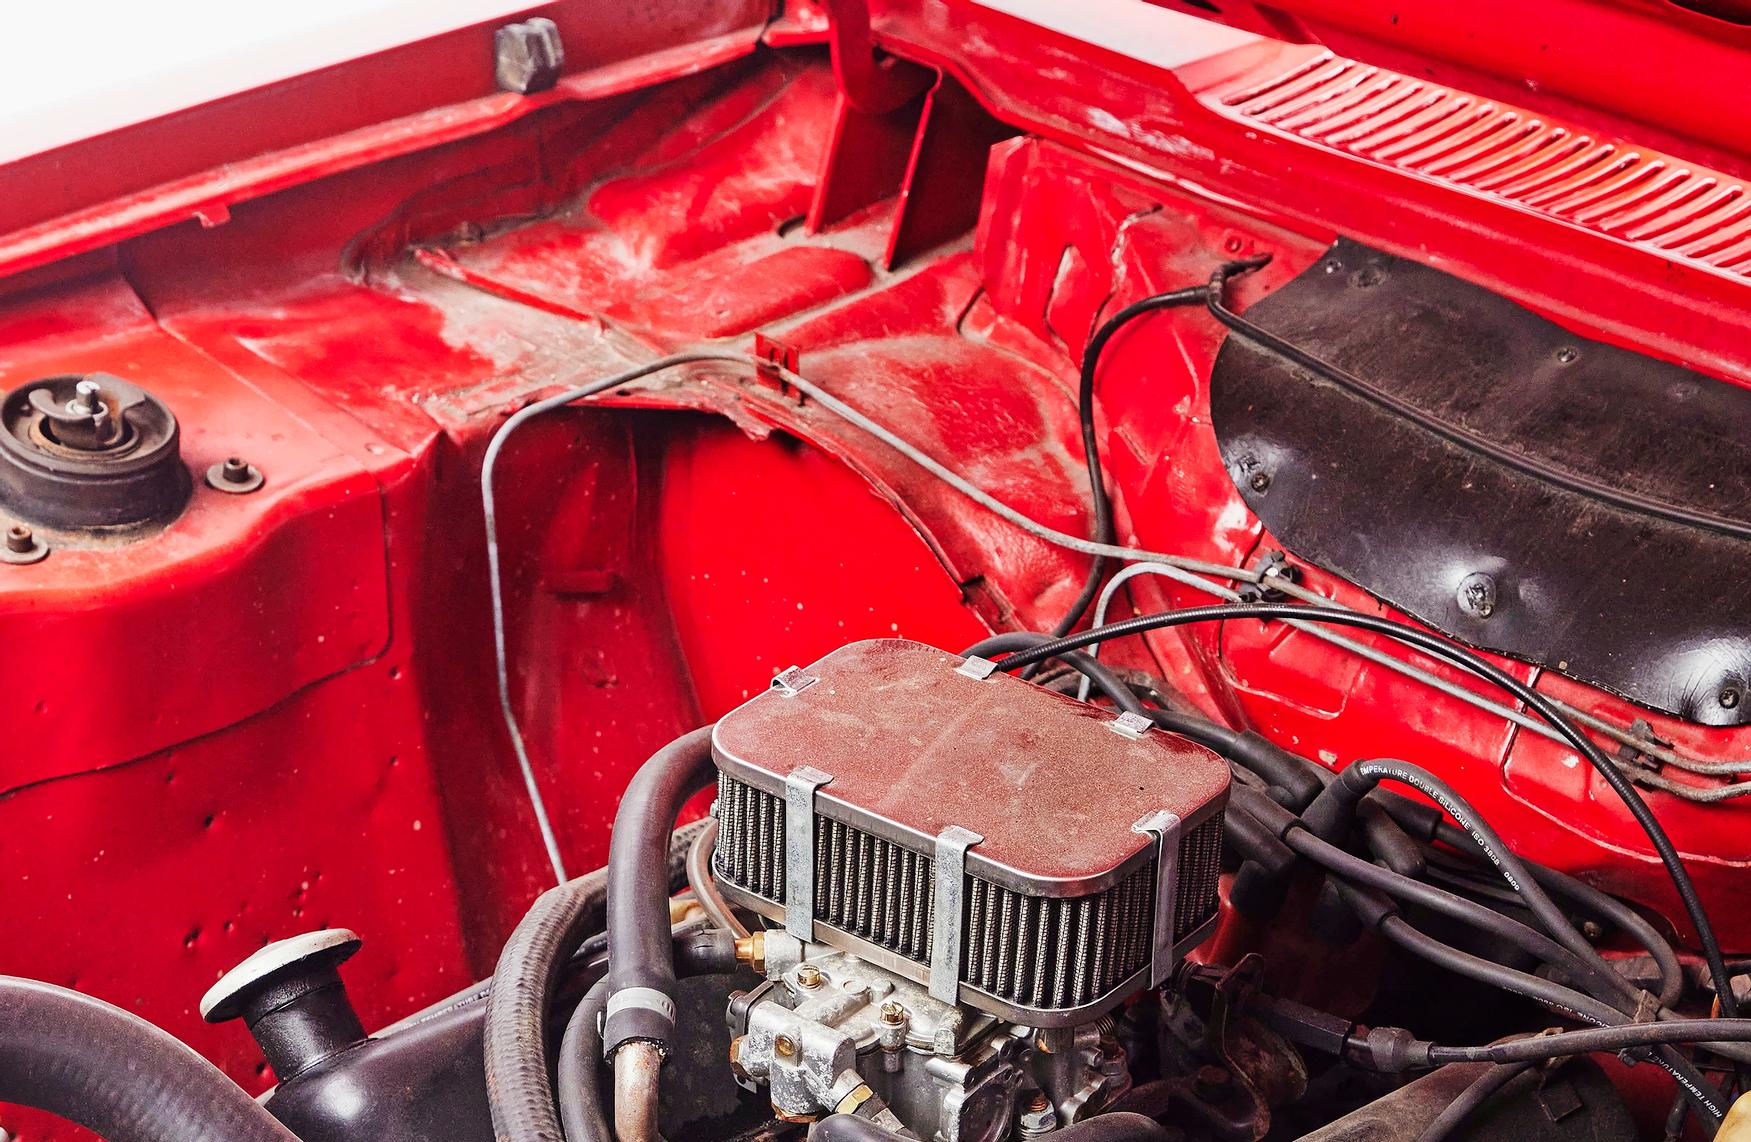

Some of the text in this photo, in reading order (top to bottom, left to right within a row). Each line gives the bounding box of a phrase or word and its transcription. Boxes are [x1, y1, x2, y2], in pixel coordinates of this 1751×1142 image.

[1409, 774, 1439, 799] DOUBLE
[1438, 797, 1472, 831] SILICONE
[1471, 830, 1485, 846] ISO
[1703, 1100, 1723, 1118] HIGH
